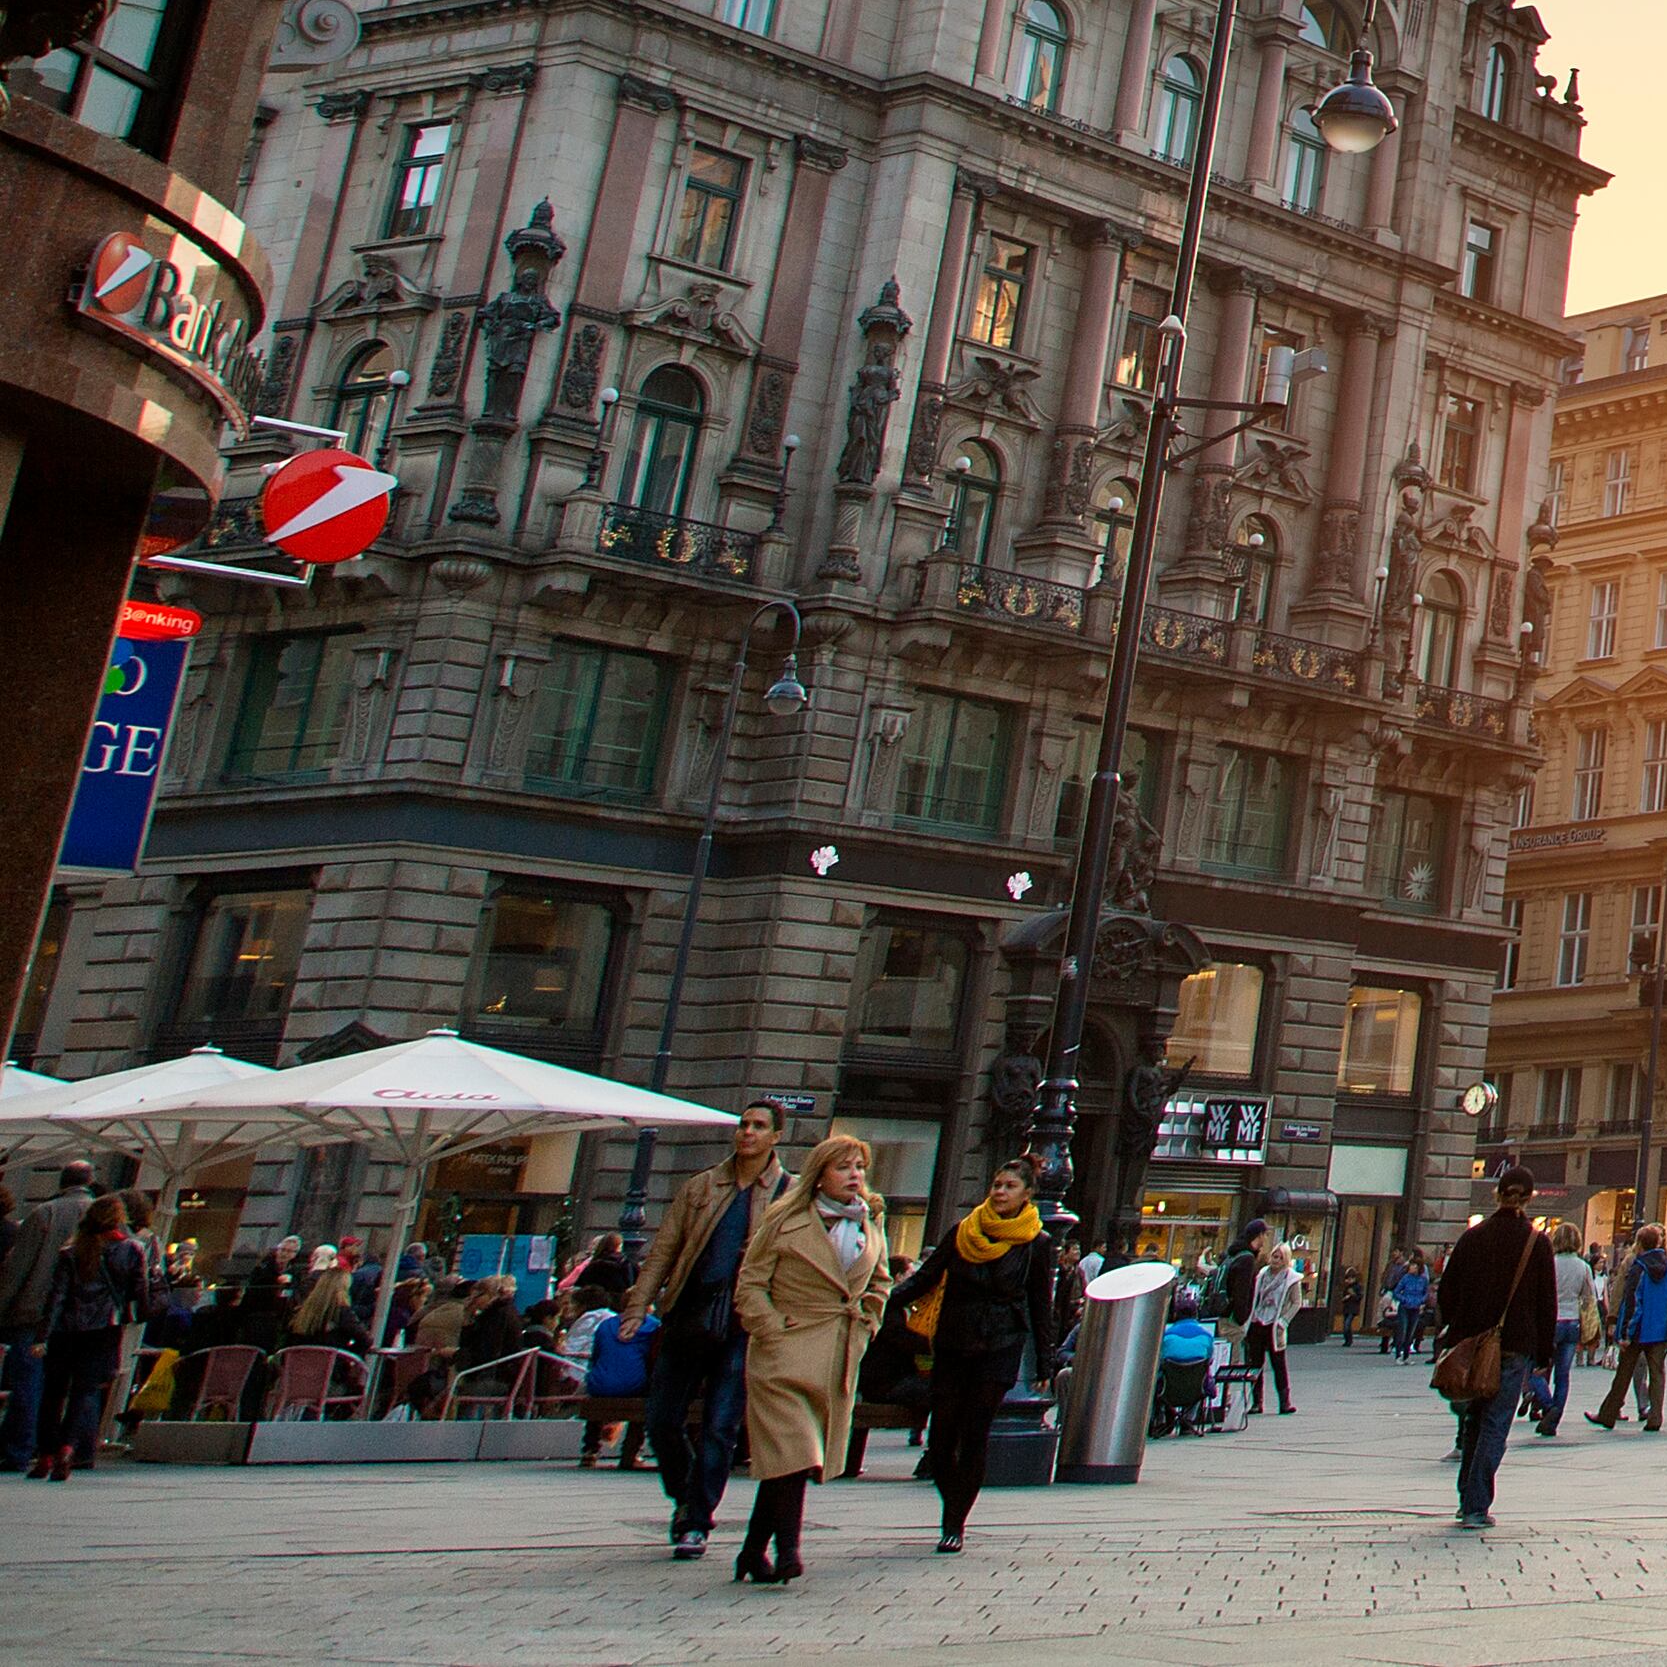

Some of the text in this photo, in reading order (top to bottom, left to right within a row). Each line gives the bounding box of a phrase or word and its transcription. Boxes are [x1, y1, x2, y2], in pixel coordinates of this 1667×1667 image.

[141, 258, 224, 374] Bank
[1517, 829, 1604, 848] INSURANCE GROUP
